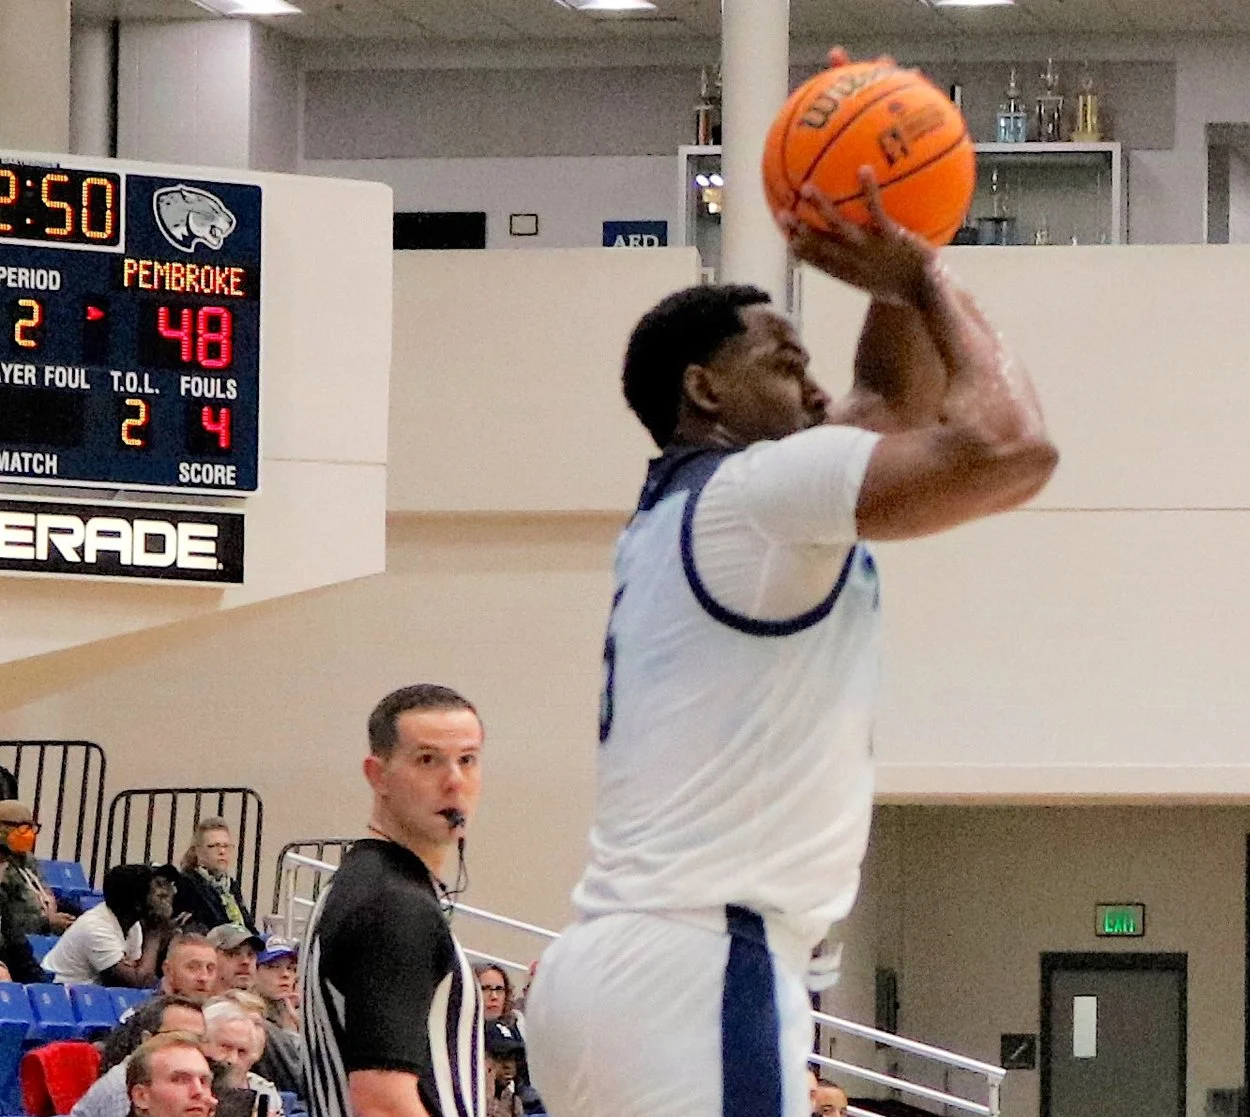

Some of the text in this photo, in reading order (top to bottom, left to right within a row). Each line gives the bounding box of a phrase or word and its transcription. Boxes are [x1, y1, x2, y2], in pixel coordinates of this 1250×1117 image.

[614, 233, 659, 247] AED
[0, 266, 61, 291] PERIOD
[123, 258, 245, 296] PEMBROKE
[14, 298, 40, 348] 2
[157, 305, 233, 369] 48
[0, 362, 91, 390] YER FOUL
[109, 370, 161, 395] T.O.L.
[180, 375, 238, 400] FOULS
[120, 398, 147, 447] 2
[201, 405, 232, 450] 4
[0, 450, 58, 476] MATCH
[178, 461, 237, 486] SCORE
